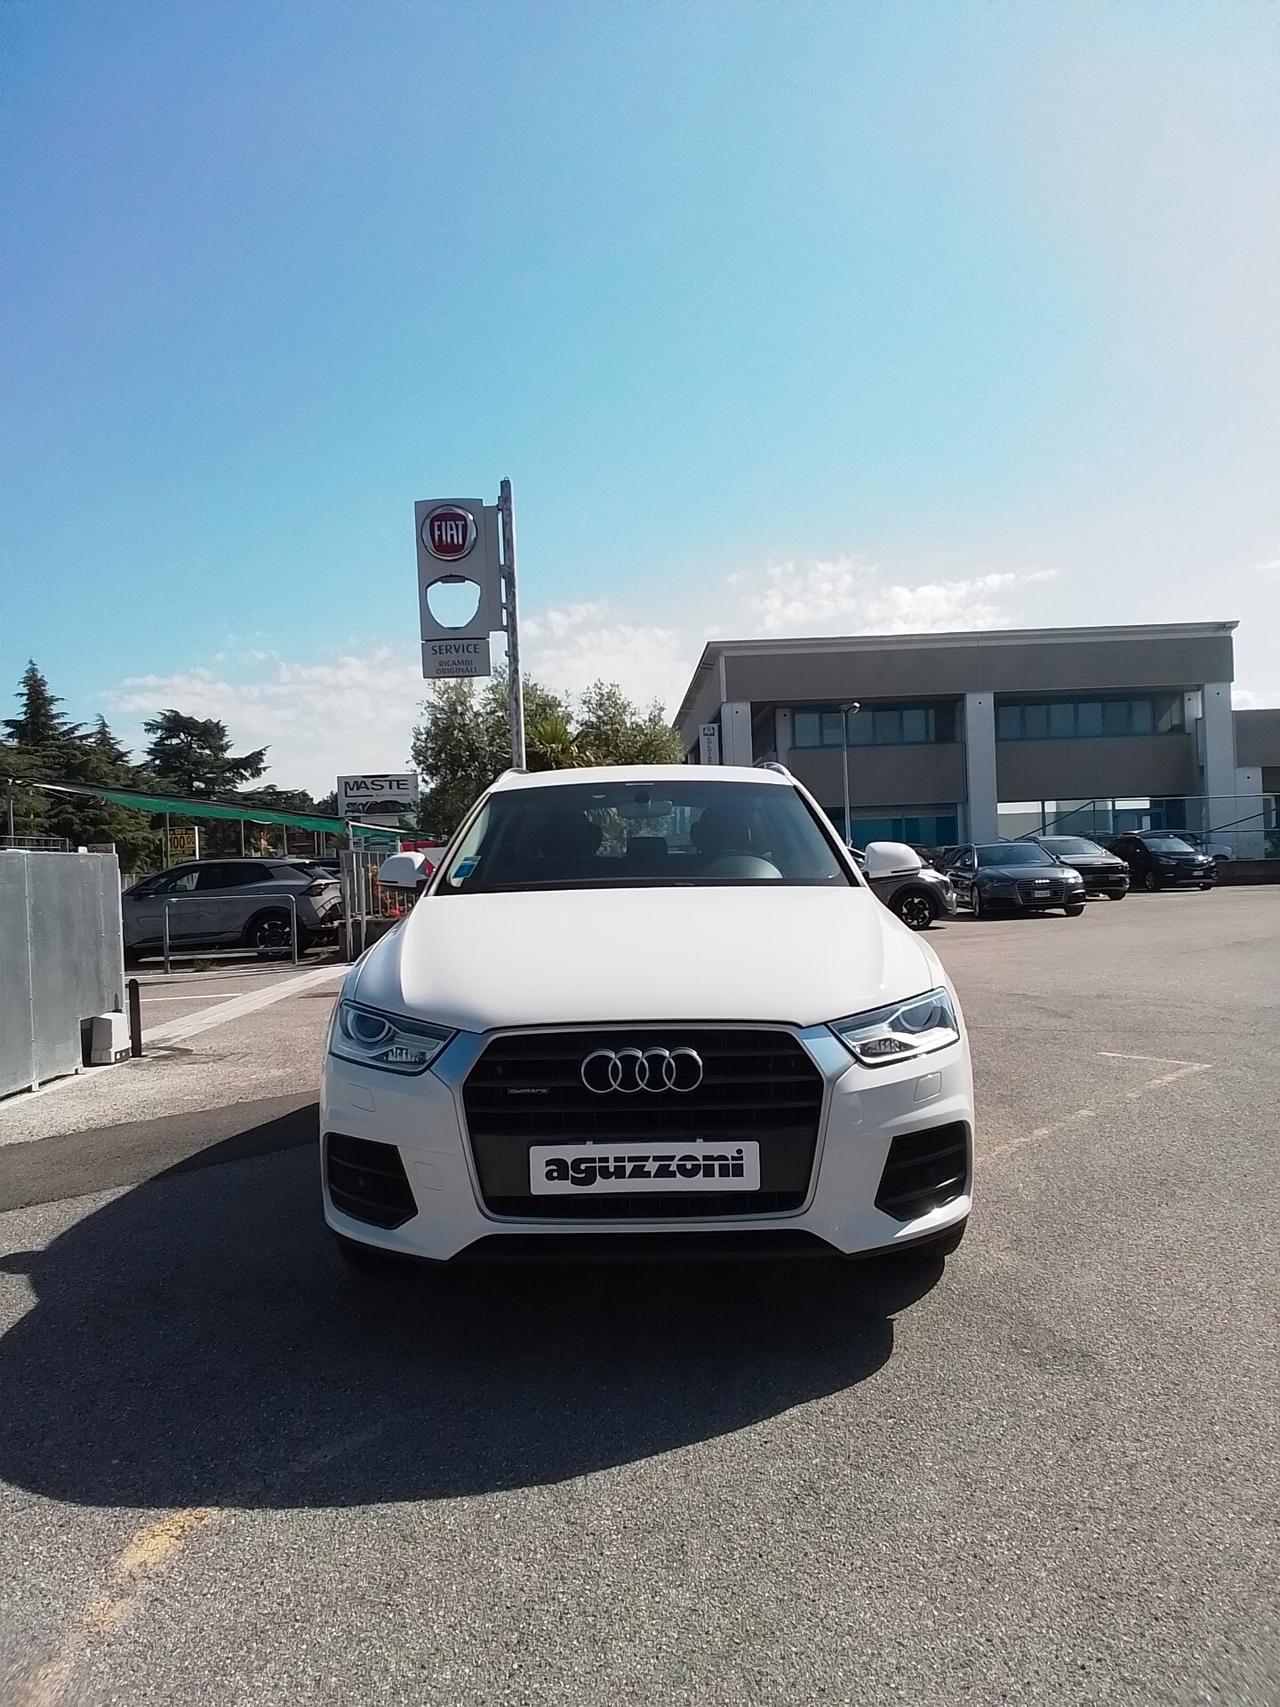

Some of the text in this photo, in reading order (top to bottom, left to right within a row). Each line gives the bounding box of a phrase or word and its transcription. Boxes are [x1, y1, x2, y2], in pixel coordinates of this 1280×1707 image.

[433, 520, 466, 546] FIAT
[431, 643, 480, 655] SERVICE
[438, 659, 473, 667] RICAMBI
[435, 667, 478, 675] ORIGINALI
[544, 1147, 746, 1187] aguzzoni
